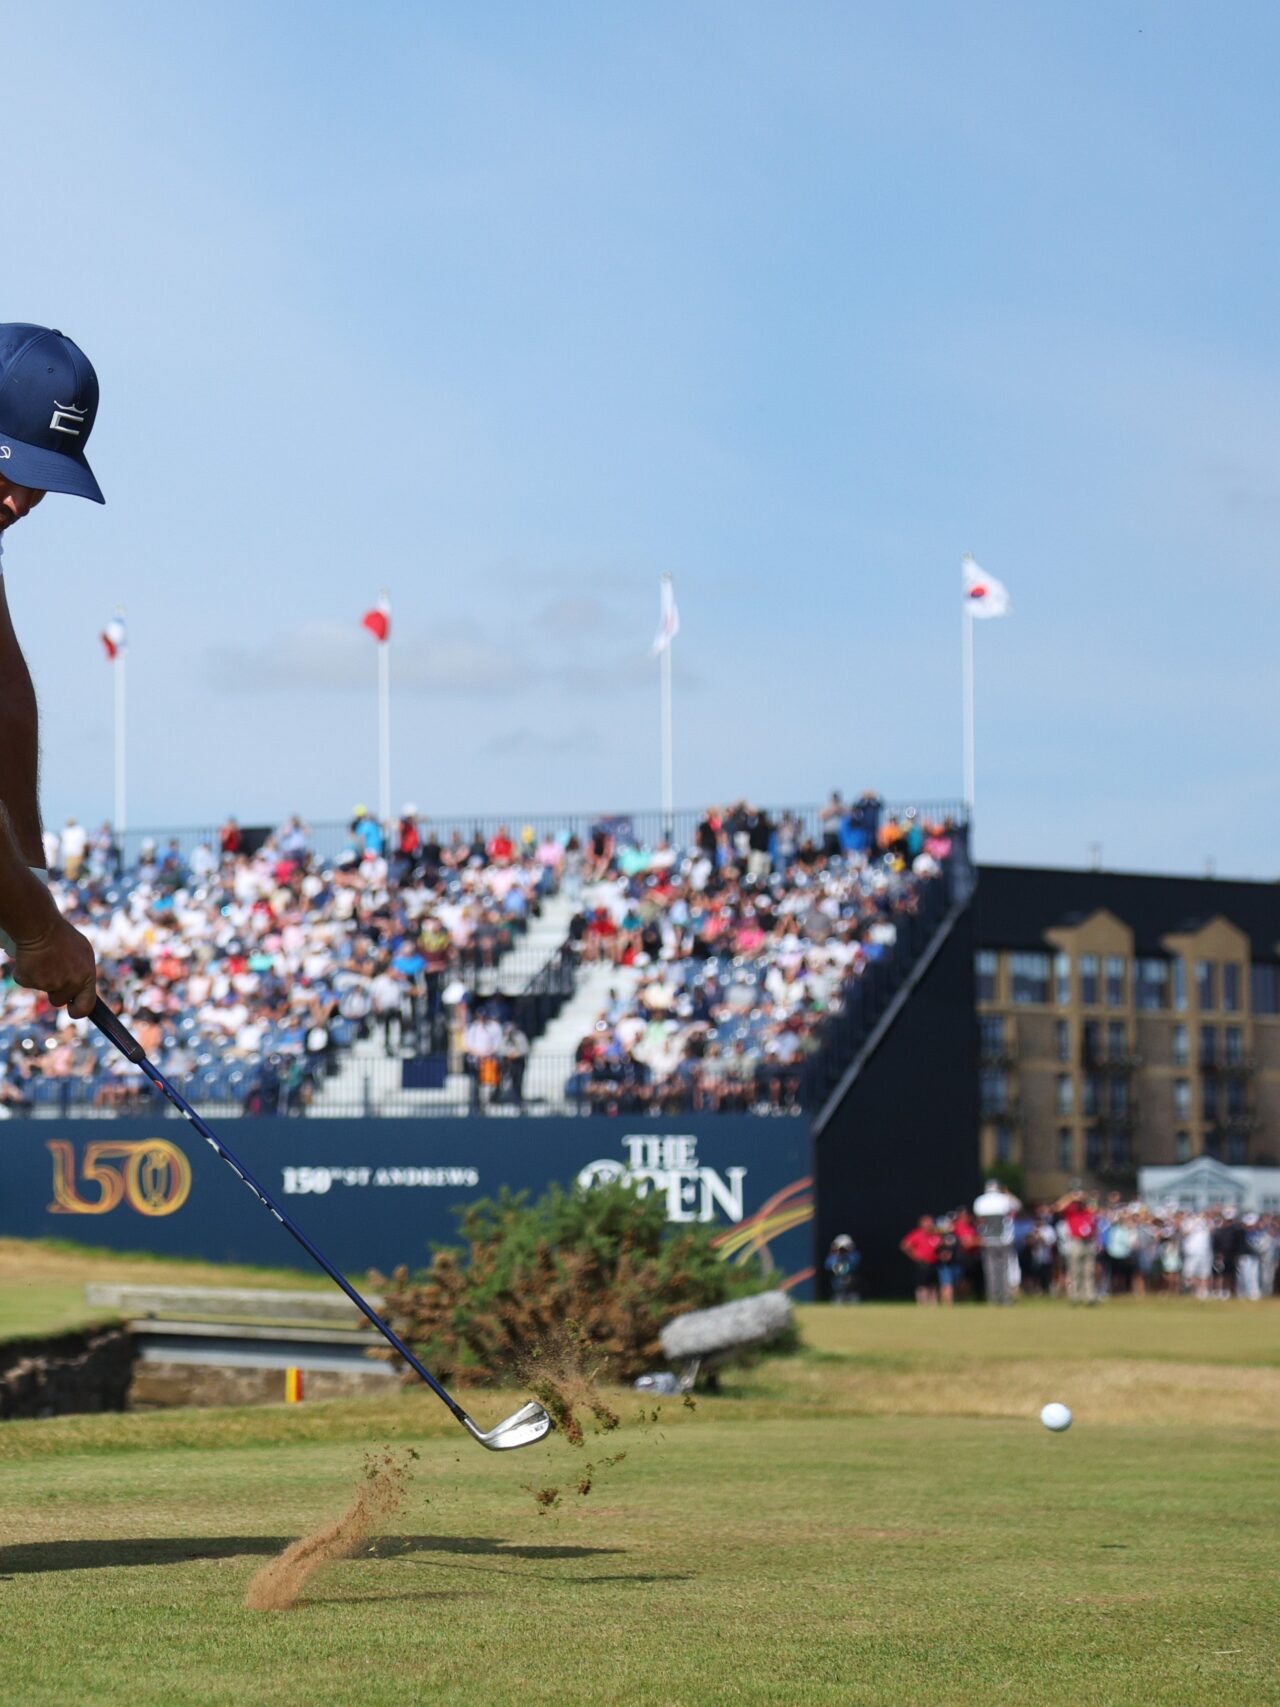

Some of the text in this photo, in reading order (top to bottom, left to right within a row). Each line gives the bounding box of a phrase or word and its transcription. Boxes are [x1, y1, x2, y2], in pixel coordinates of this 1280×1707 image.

[621, 1134, 699, 1170] THE
[45, 1137, 193, 1217] 150
[373, 1166, 479, 1188] ANDREWS
